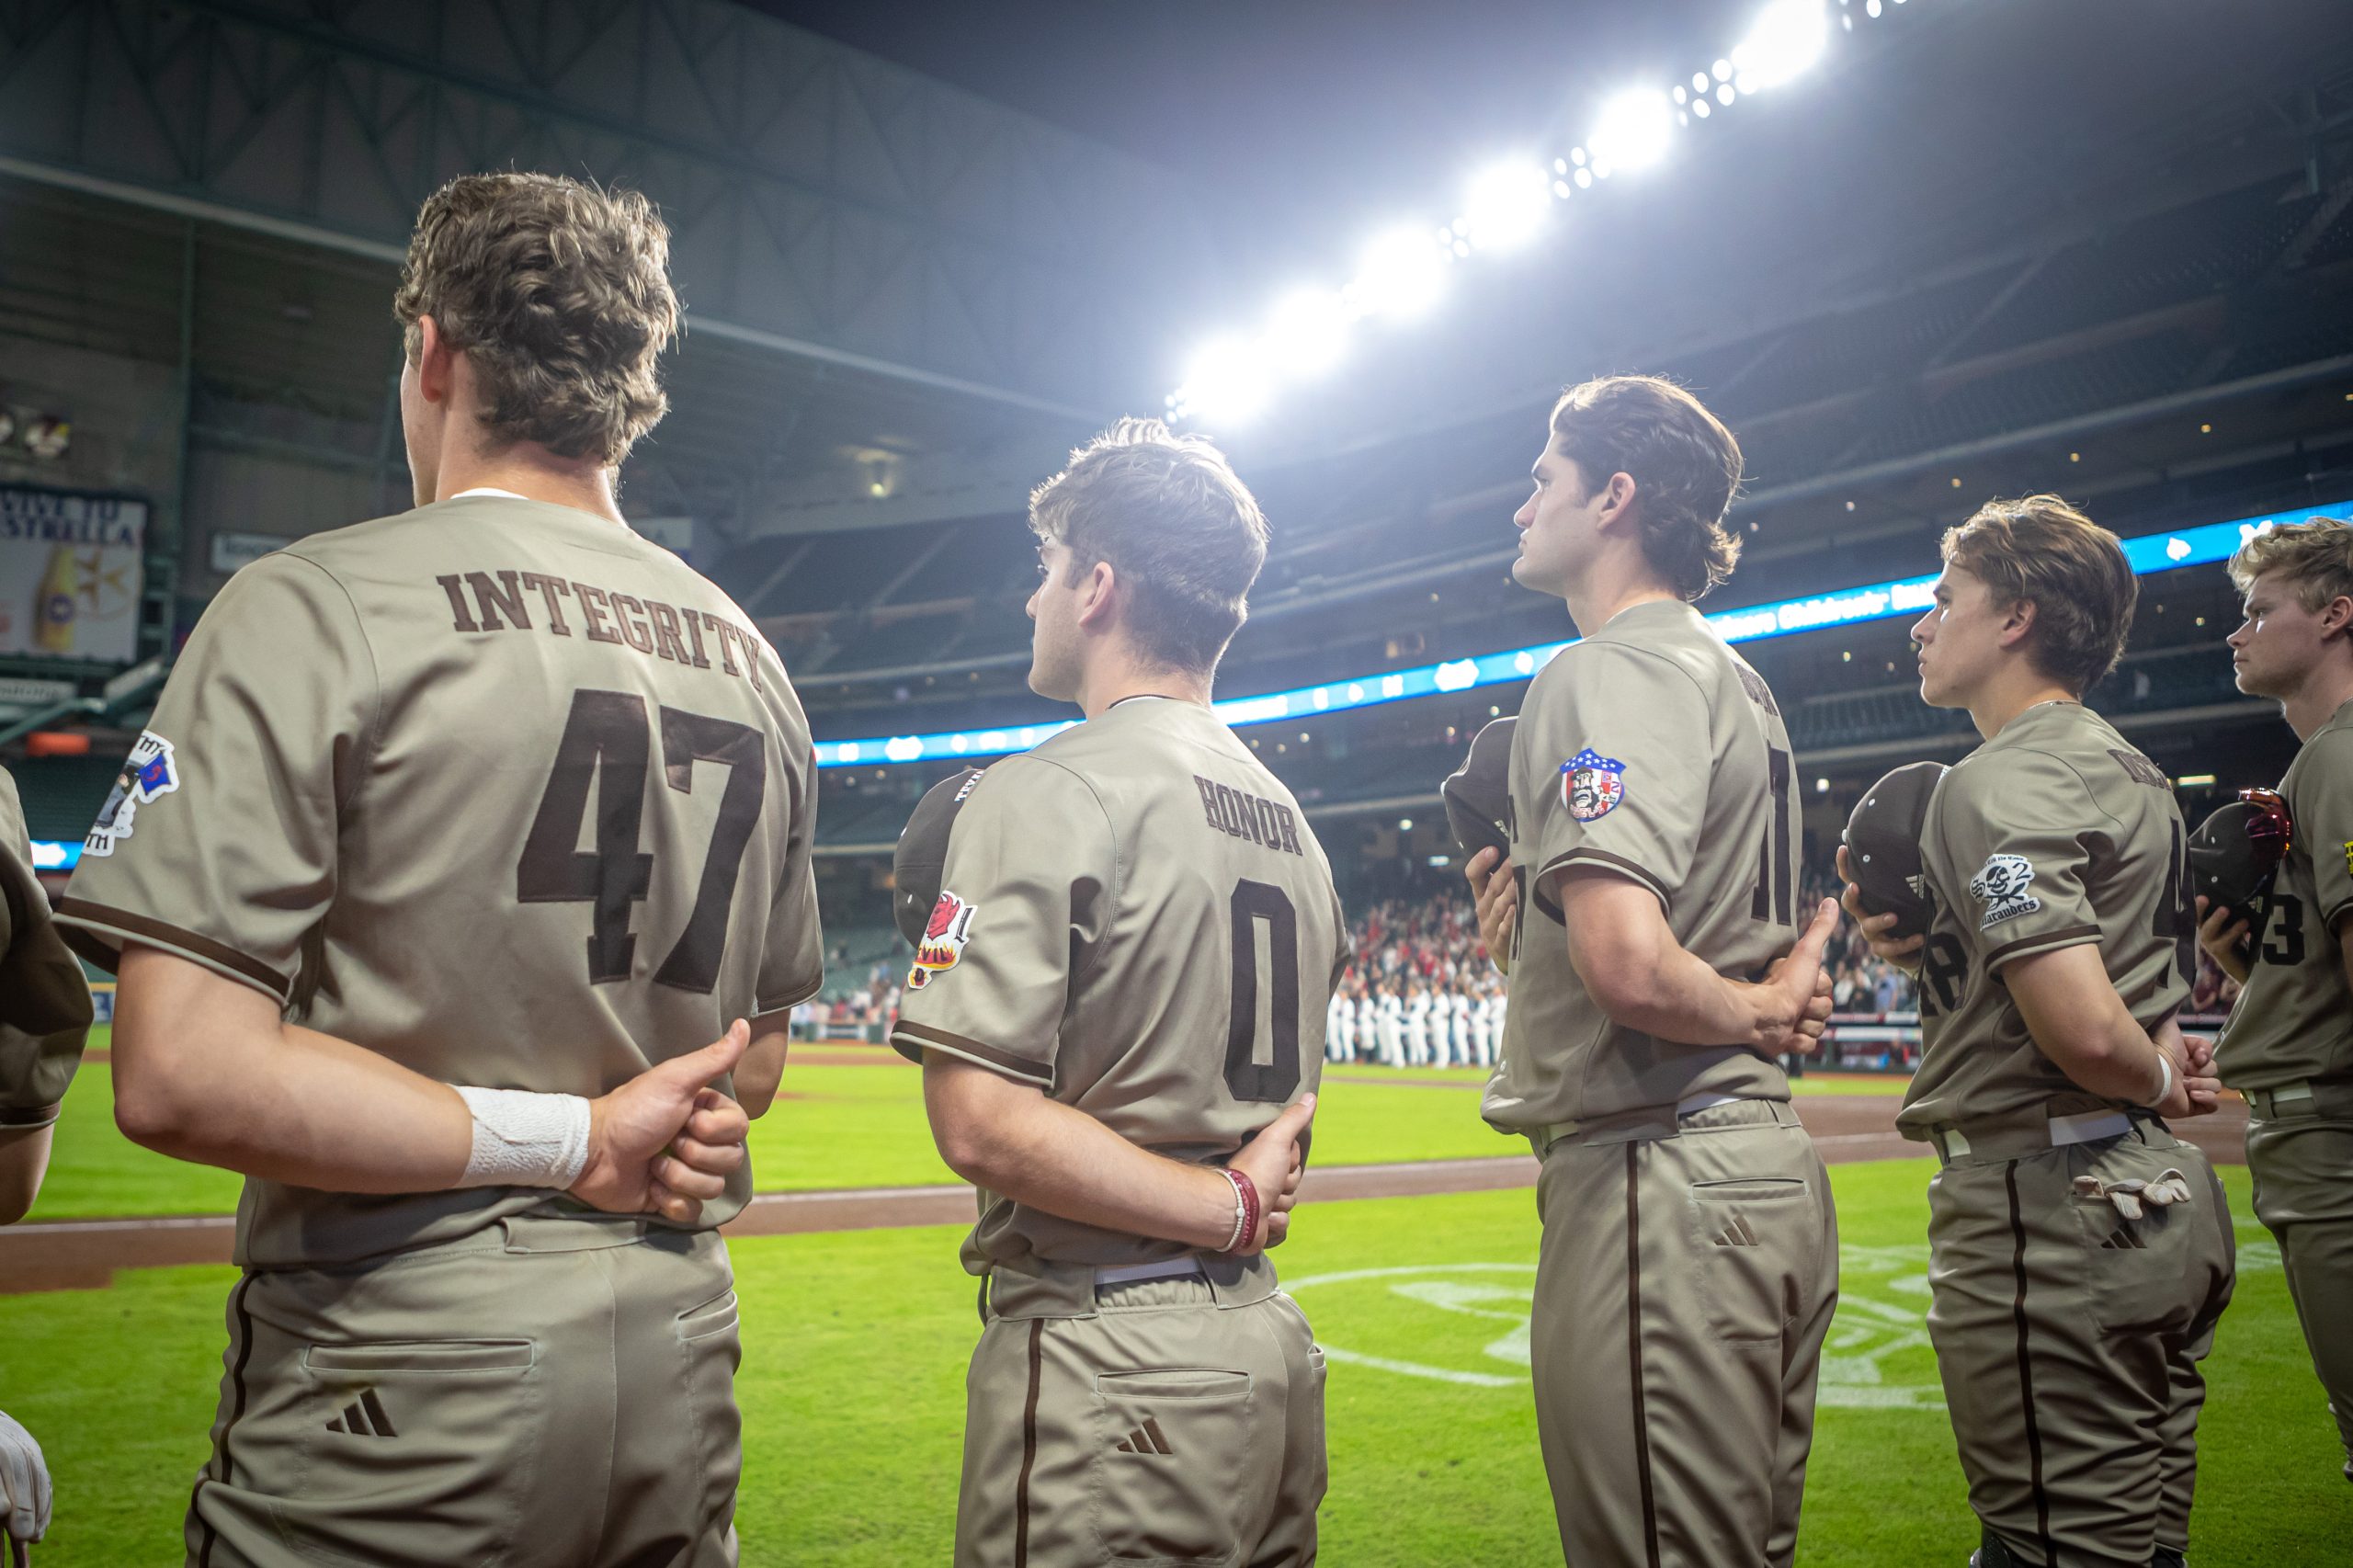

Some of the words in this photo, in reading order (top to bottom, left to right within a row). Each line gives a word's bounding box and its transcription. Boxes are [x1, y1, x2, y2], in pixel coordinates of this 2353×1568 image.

[436, 570, 762, 693] INTEGRITY
[517, 688, 766, 994] 47
[1193, 774, 1303, 857] HONOR
[1223, 878, 1301, 1103] 0
